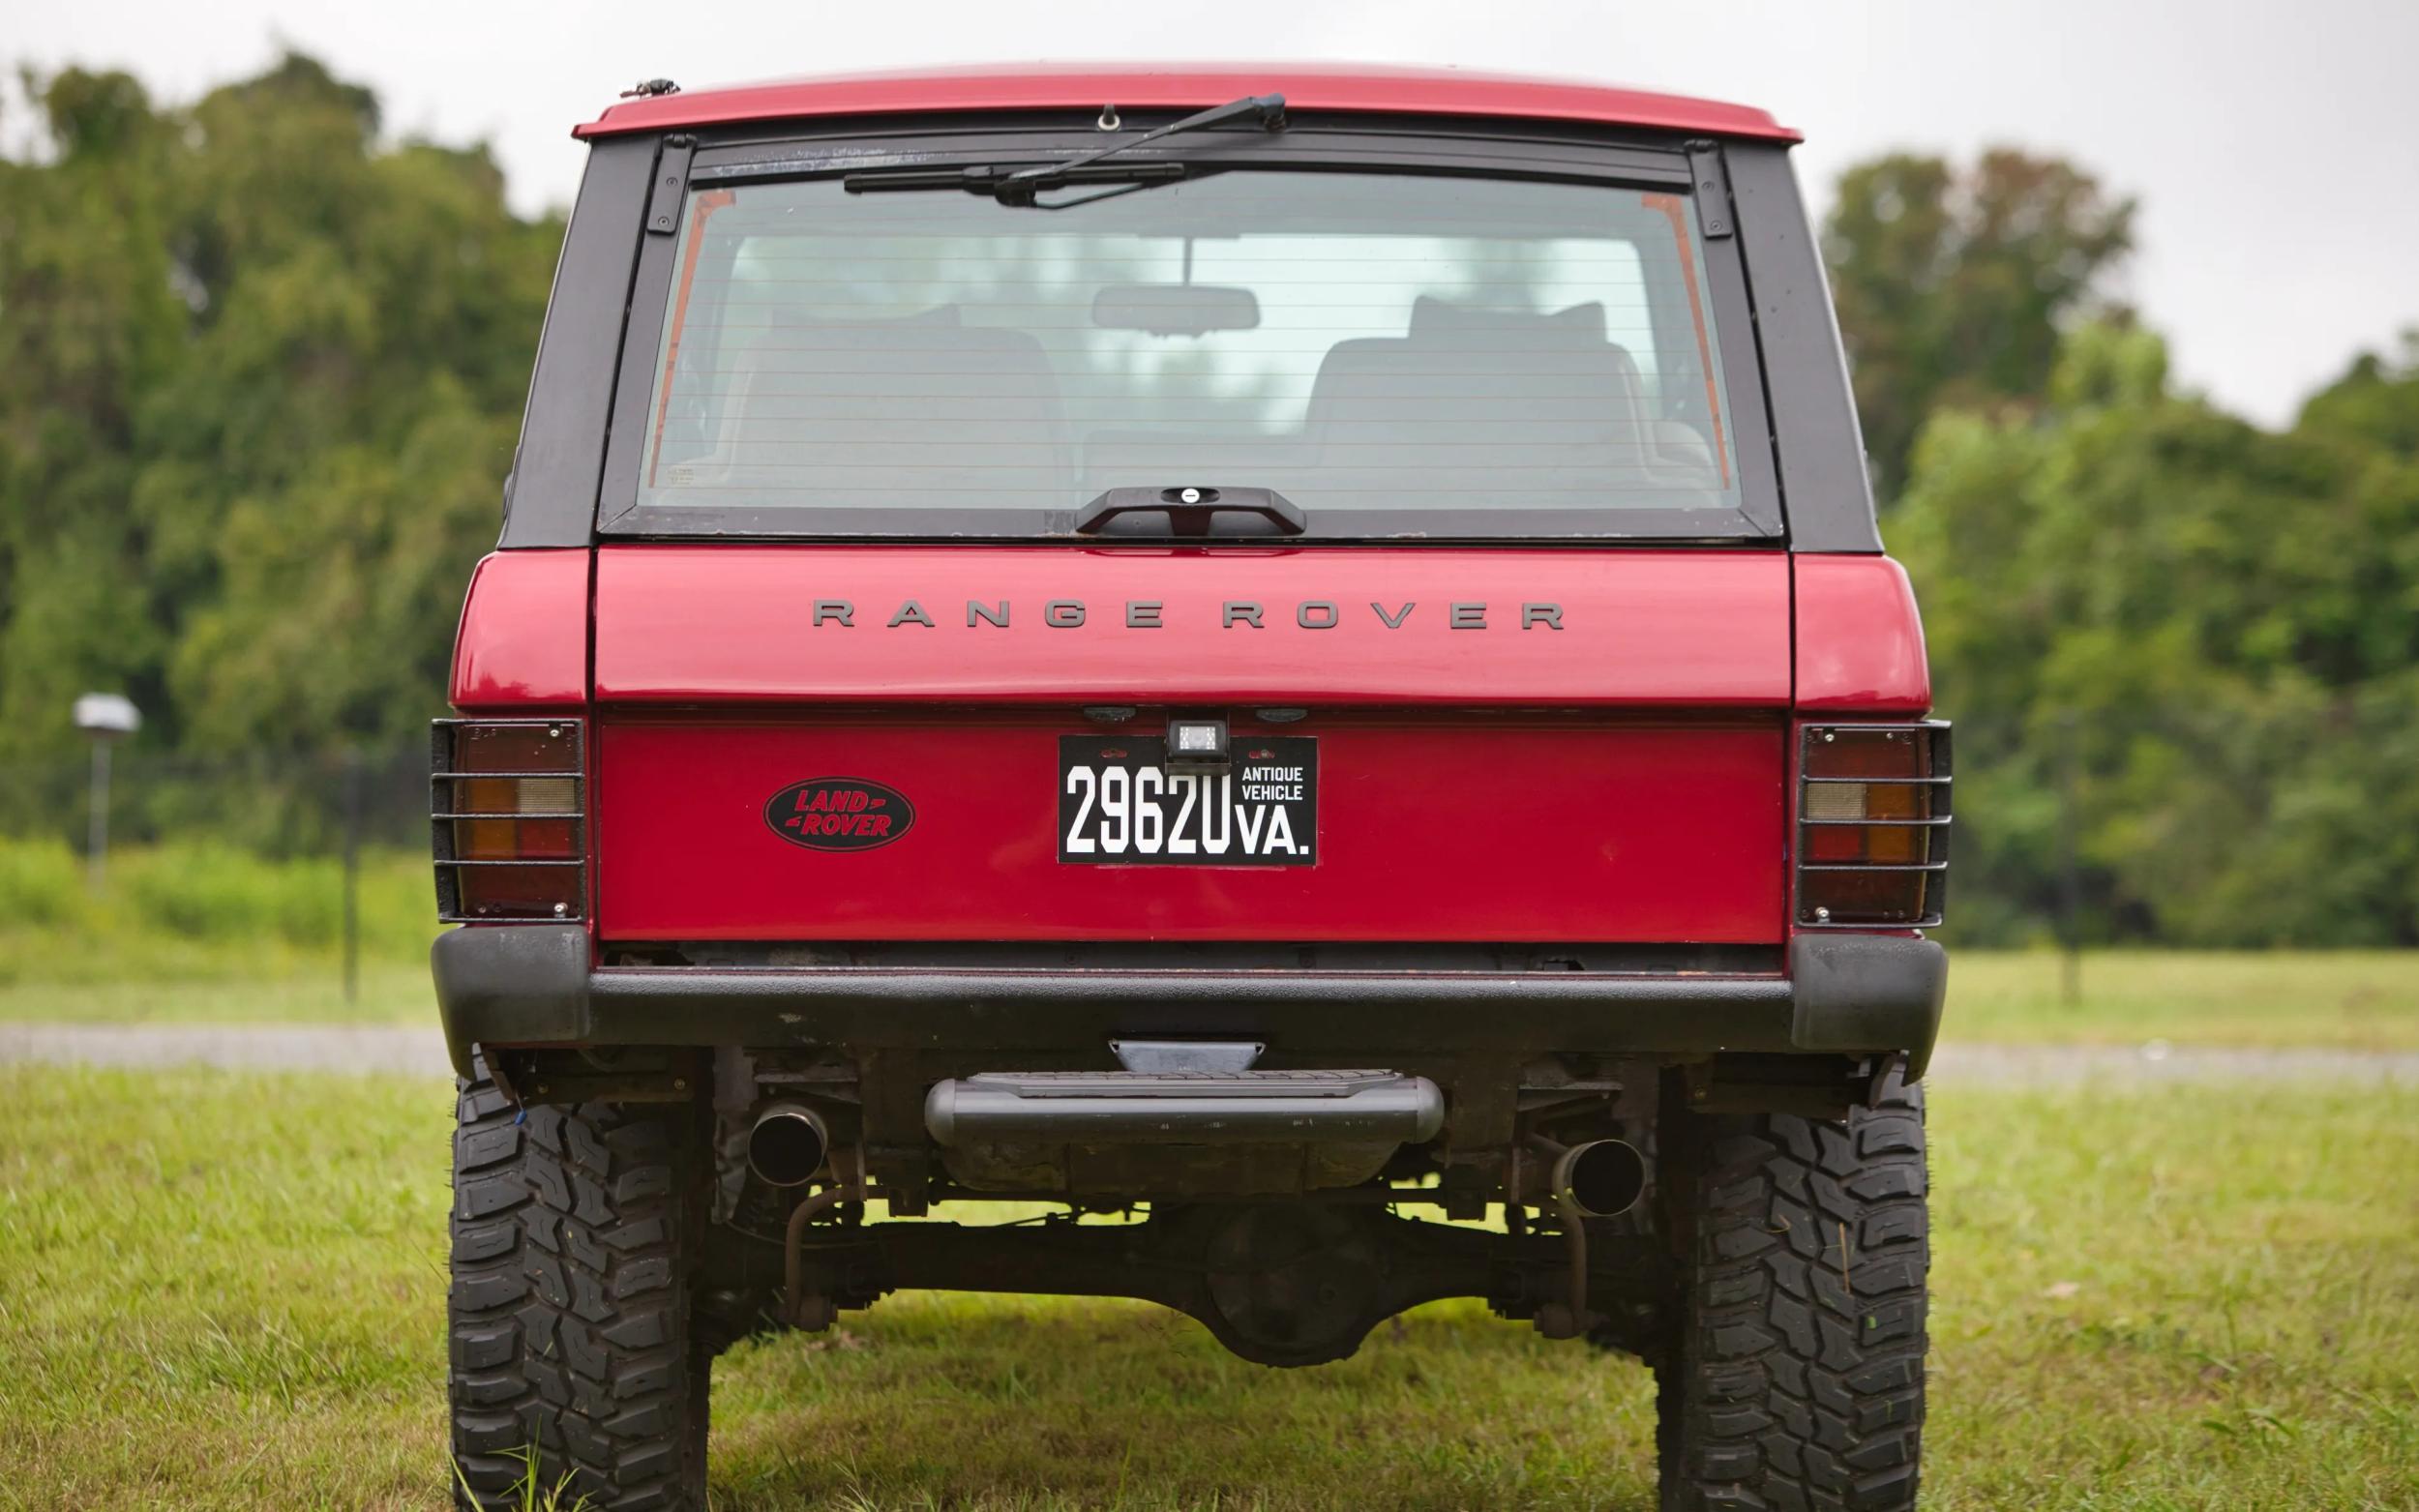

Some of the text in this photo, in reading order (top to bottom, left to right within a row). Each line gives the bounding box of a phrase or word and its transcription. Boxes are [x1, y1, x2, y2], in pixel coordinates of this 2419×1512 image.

[813, 599, 1565, 630] RANGE ROVER
[1241, 766, 1303, 782] ANTIQUE
[794, 789, 869, 812] LAND
[1241, 785, 1303, 801] VEHICLE
[800, 814, 892, 837] ROVER
